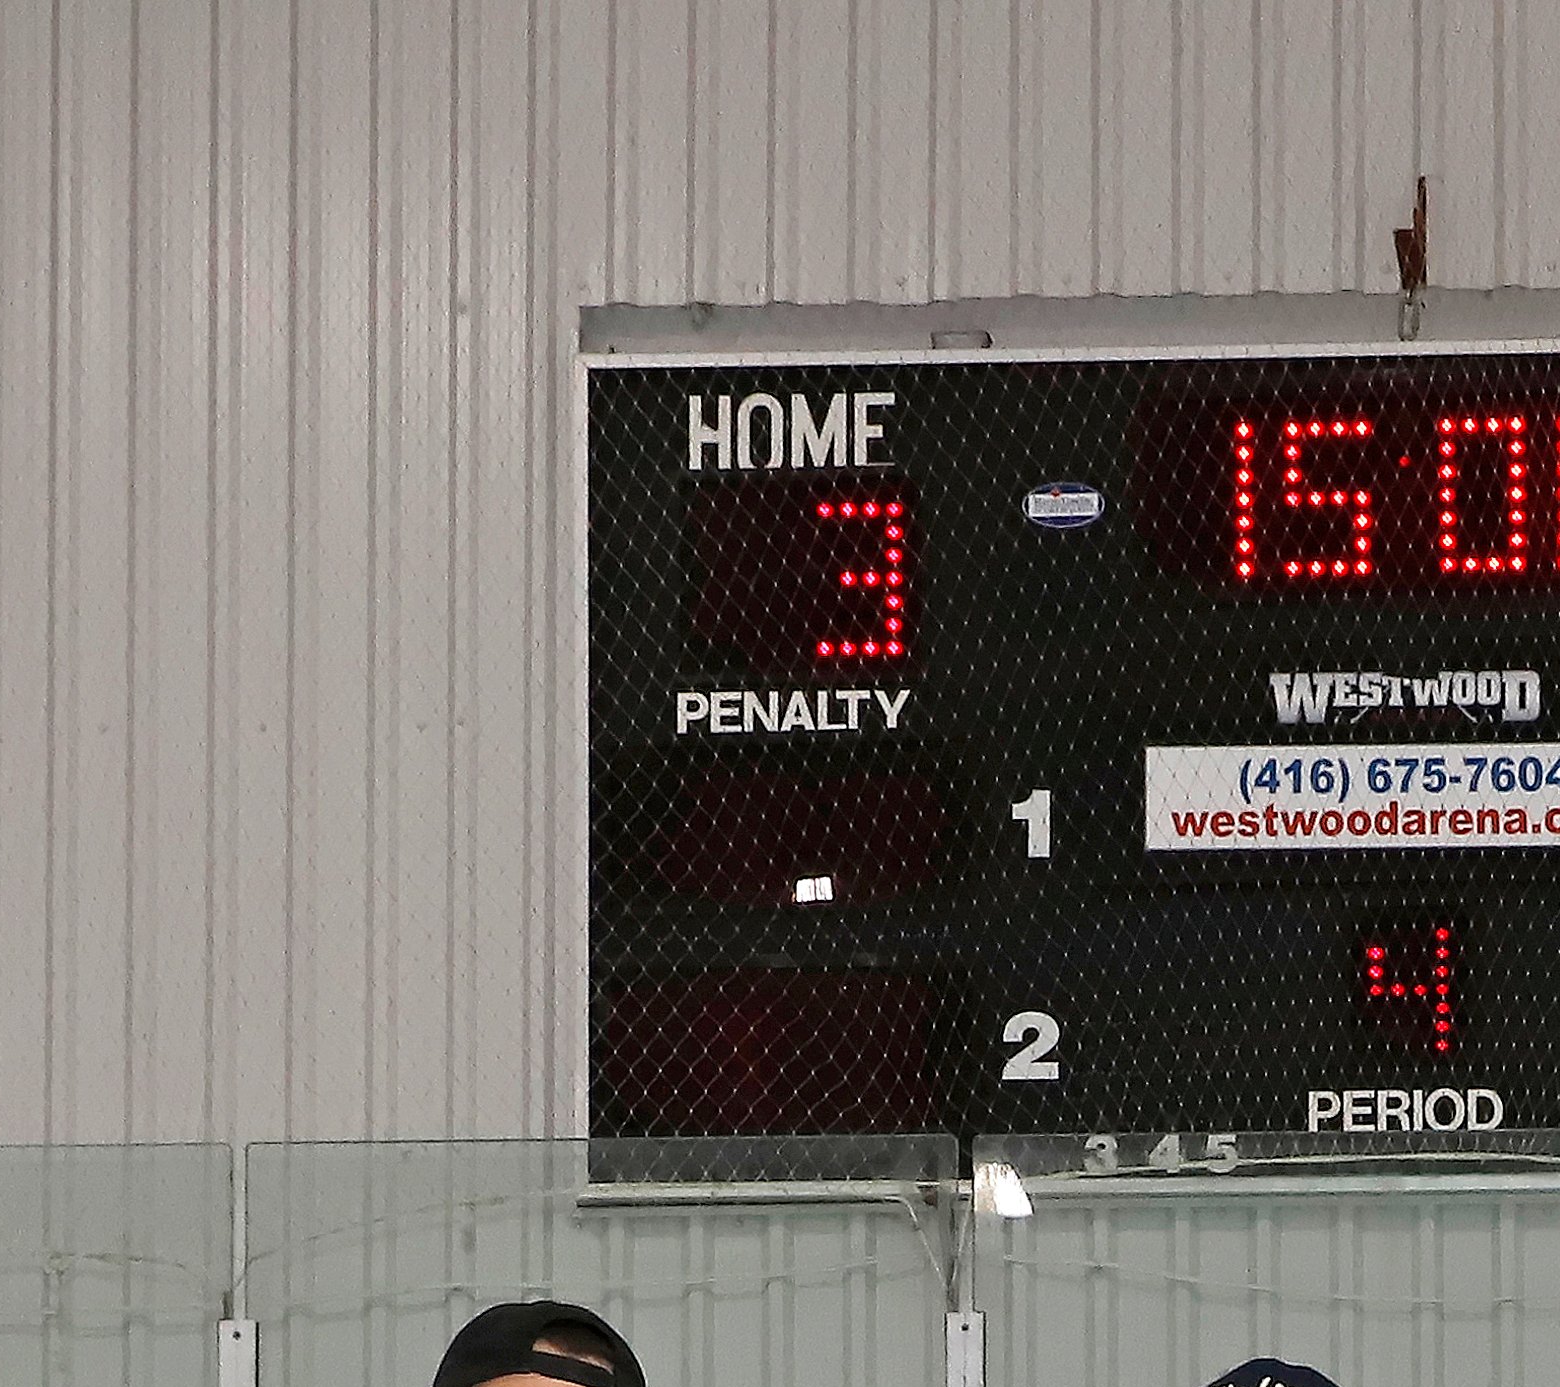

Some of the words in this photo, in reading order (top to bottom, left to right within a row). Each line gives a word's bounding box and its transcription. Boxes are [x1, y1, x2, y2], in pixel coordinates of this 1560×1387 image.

[688, 392, 896, 470] HOME
[817, 501, 904, 657] 3
[676, 689, 911, 735] PENALTY
[1269, 670, 1540, 724] WESTWOOD
[1240, 758, 1350, 803] (416)
[1012, 789, 1052, 858] 1
[1368, 927, 1449, 1053] 4
[1002, 1011, 1060, 1081] 2
[1308, 1088, 1504, 1133] PERIOD
[1085, 1134, 1120, 1173] 3
[1148, 1134, 1182, 1174] 4
[1205, 1134, 1241, 1174] 5
